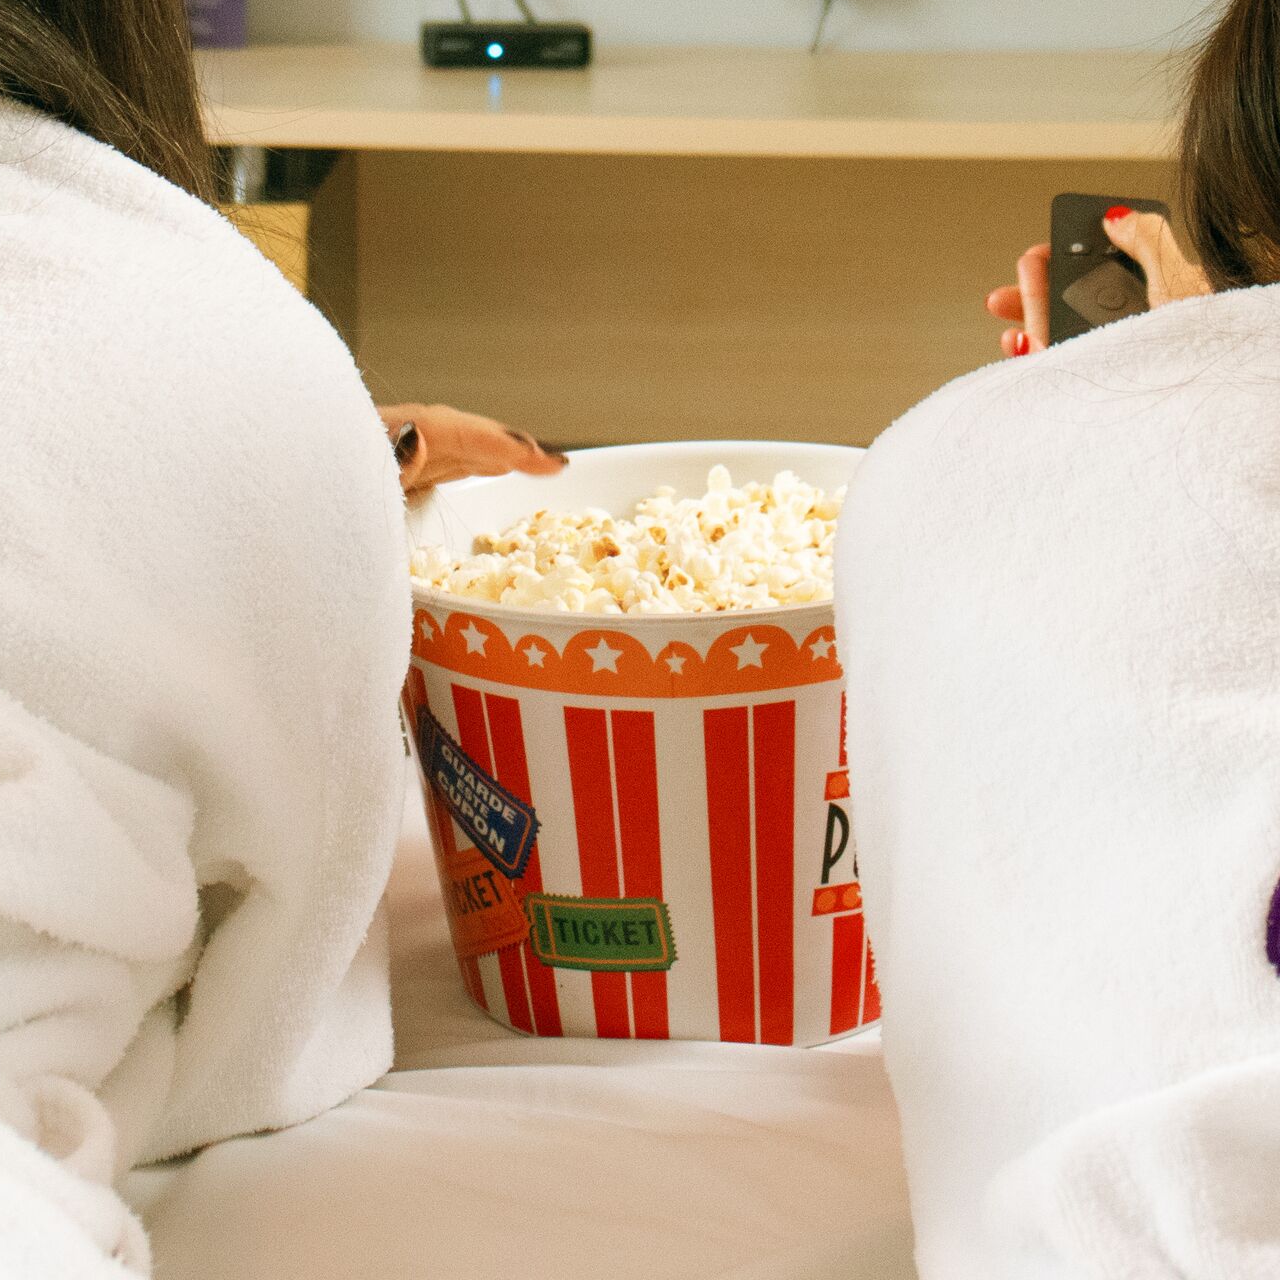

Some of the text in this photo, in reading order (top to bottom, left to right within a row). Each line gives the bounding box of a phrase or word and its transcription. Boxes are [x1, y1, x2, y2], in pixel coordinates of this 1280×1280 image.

[437, 770, 506, 854] CUPON
[441, 744, 518, 825] GUARDE
[456, 778, 490, 819] ESTE
[552, 917, 658, 947] TICKET
